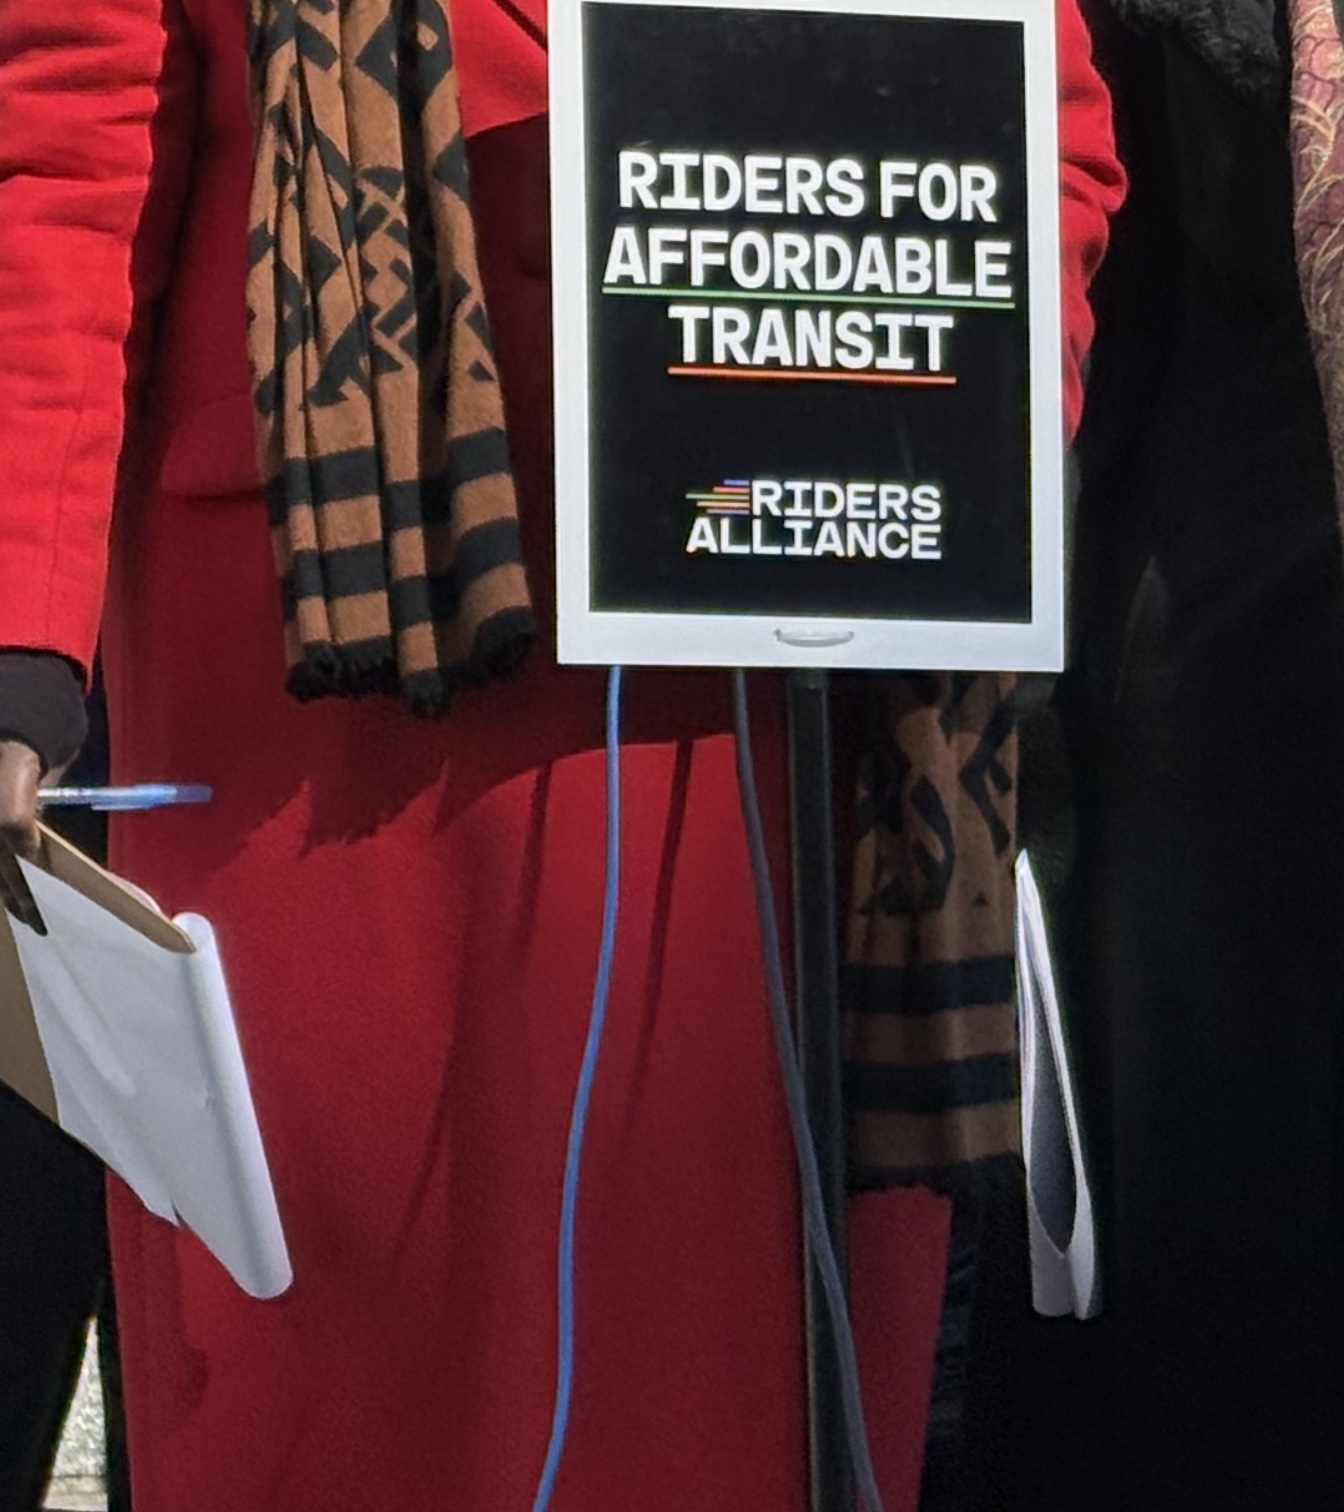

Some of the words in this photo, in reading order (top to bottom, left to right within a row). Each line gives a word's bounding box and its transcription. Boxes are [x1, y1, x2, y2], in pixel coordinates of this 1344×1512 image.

[618, 149, 865, 217] RIDERS
[879, 160, 998, 223] FOR
[602, 226, 1013, 299] AFFORDABLE
[667, 305, 955, 372] TRANSIT
[750, 479, 942, 522] RIDERS
[685, 516, 942, 560] ALLIANCE
